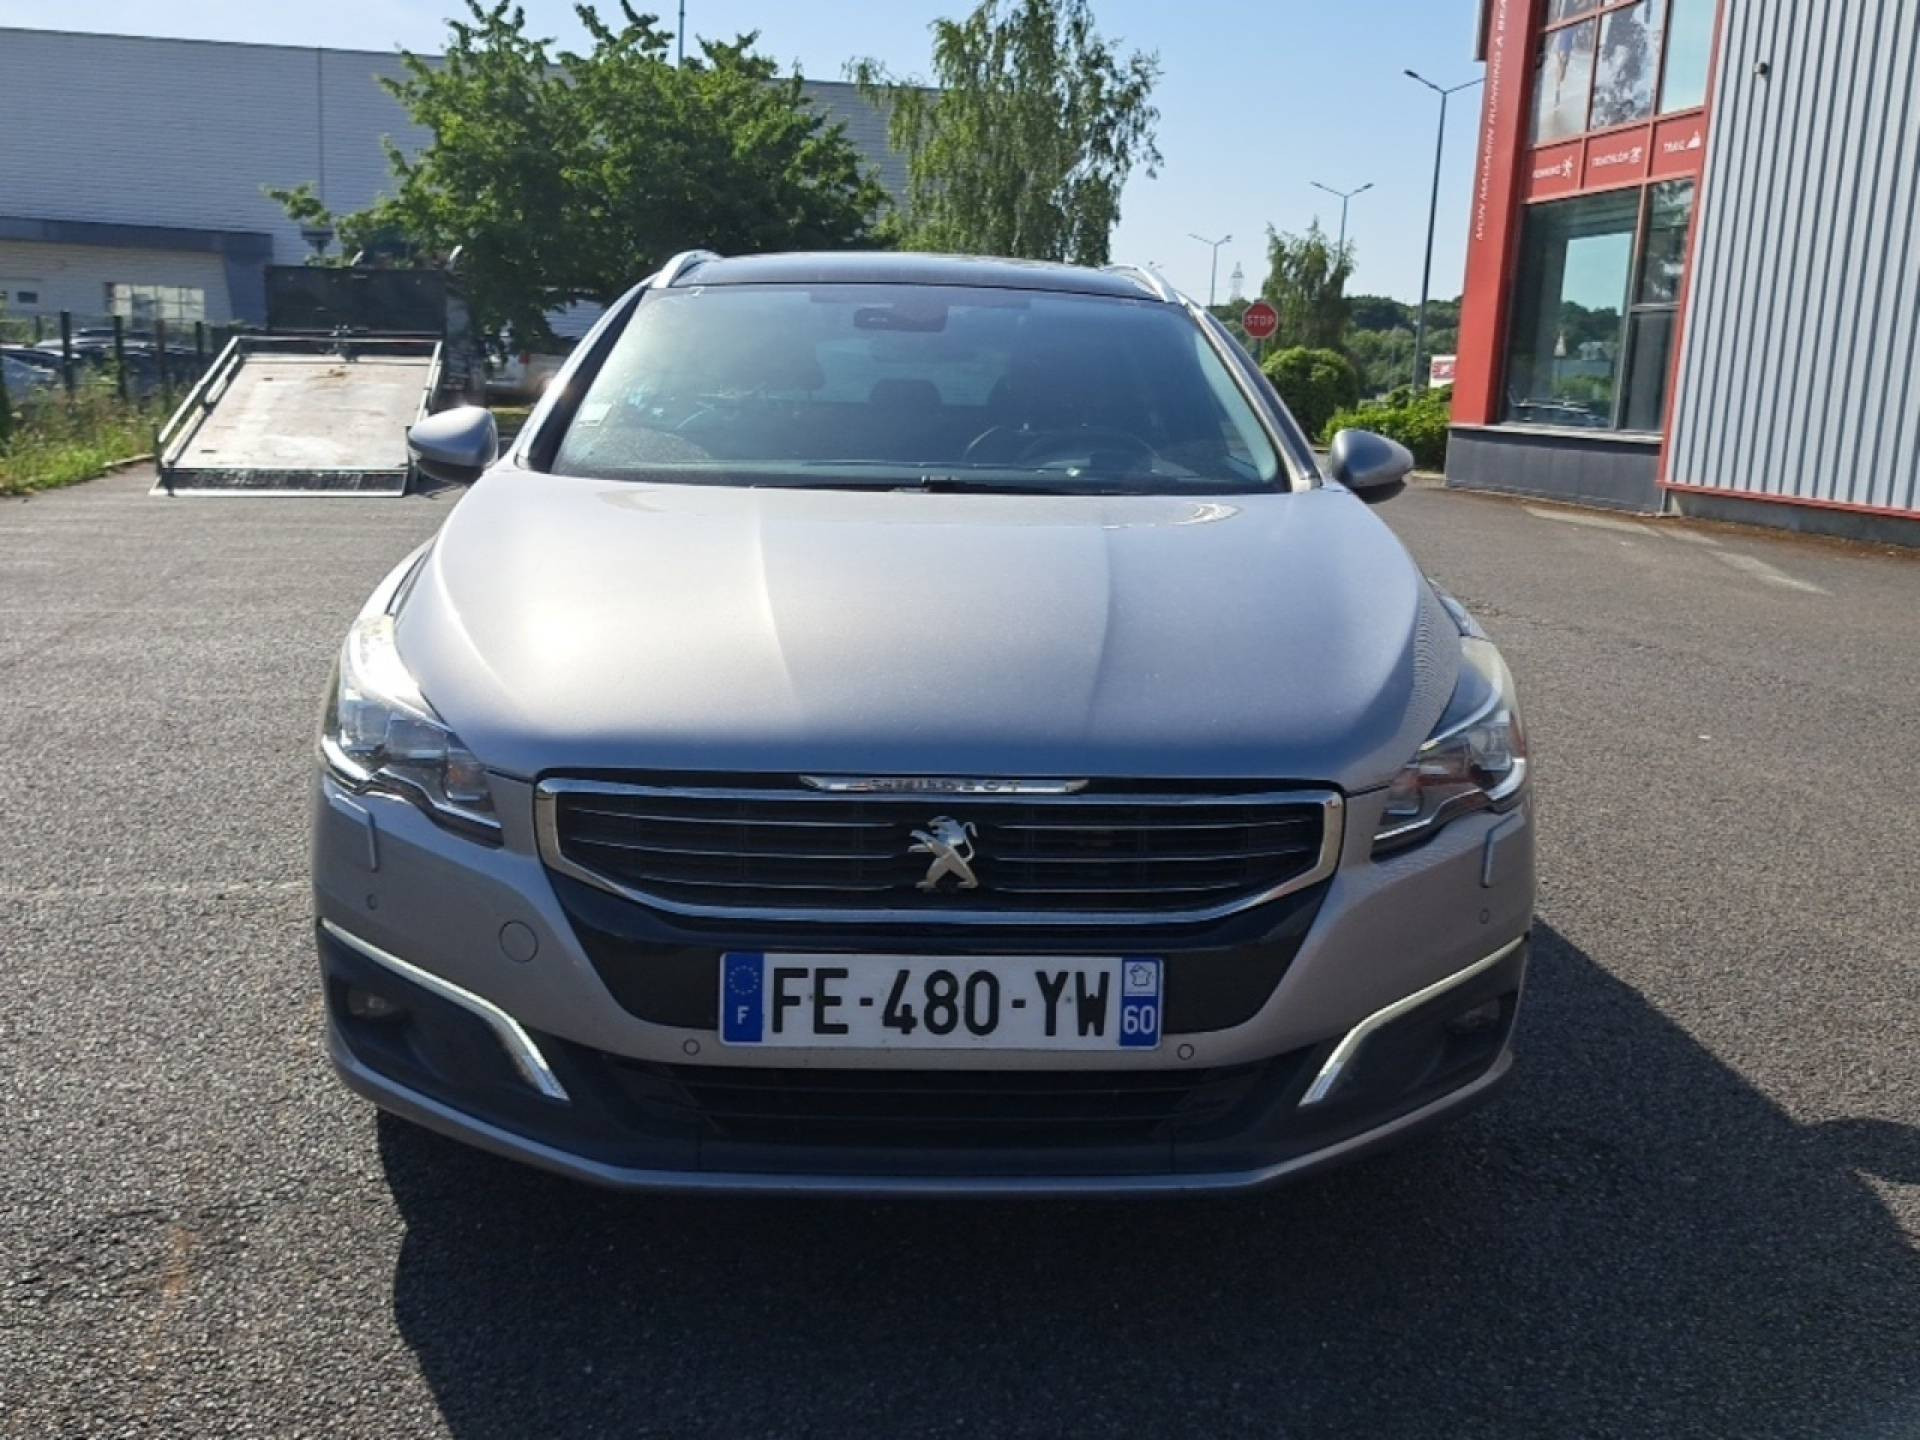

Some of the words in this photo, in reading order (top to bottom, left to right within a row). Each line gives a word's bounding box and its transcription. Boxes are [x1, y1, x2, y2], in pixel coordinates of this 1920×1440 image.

[1488, 51, 1503, 125] RUNNING
[1663, 140, 1686, 152] TRAIL
[1481, 128, 1496, 201] MAGASIN
[1476, 203, 1487, 240] MON
[1245, 314, 1275, 328] STOP
[736, 1005, 749, 1025] F
[771, 967, 1110, 1036] FE-480-YW
[1123, 1004, 1156, 1035] 60
